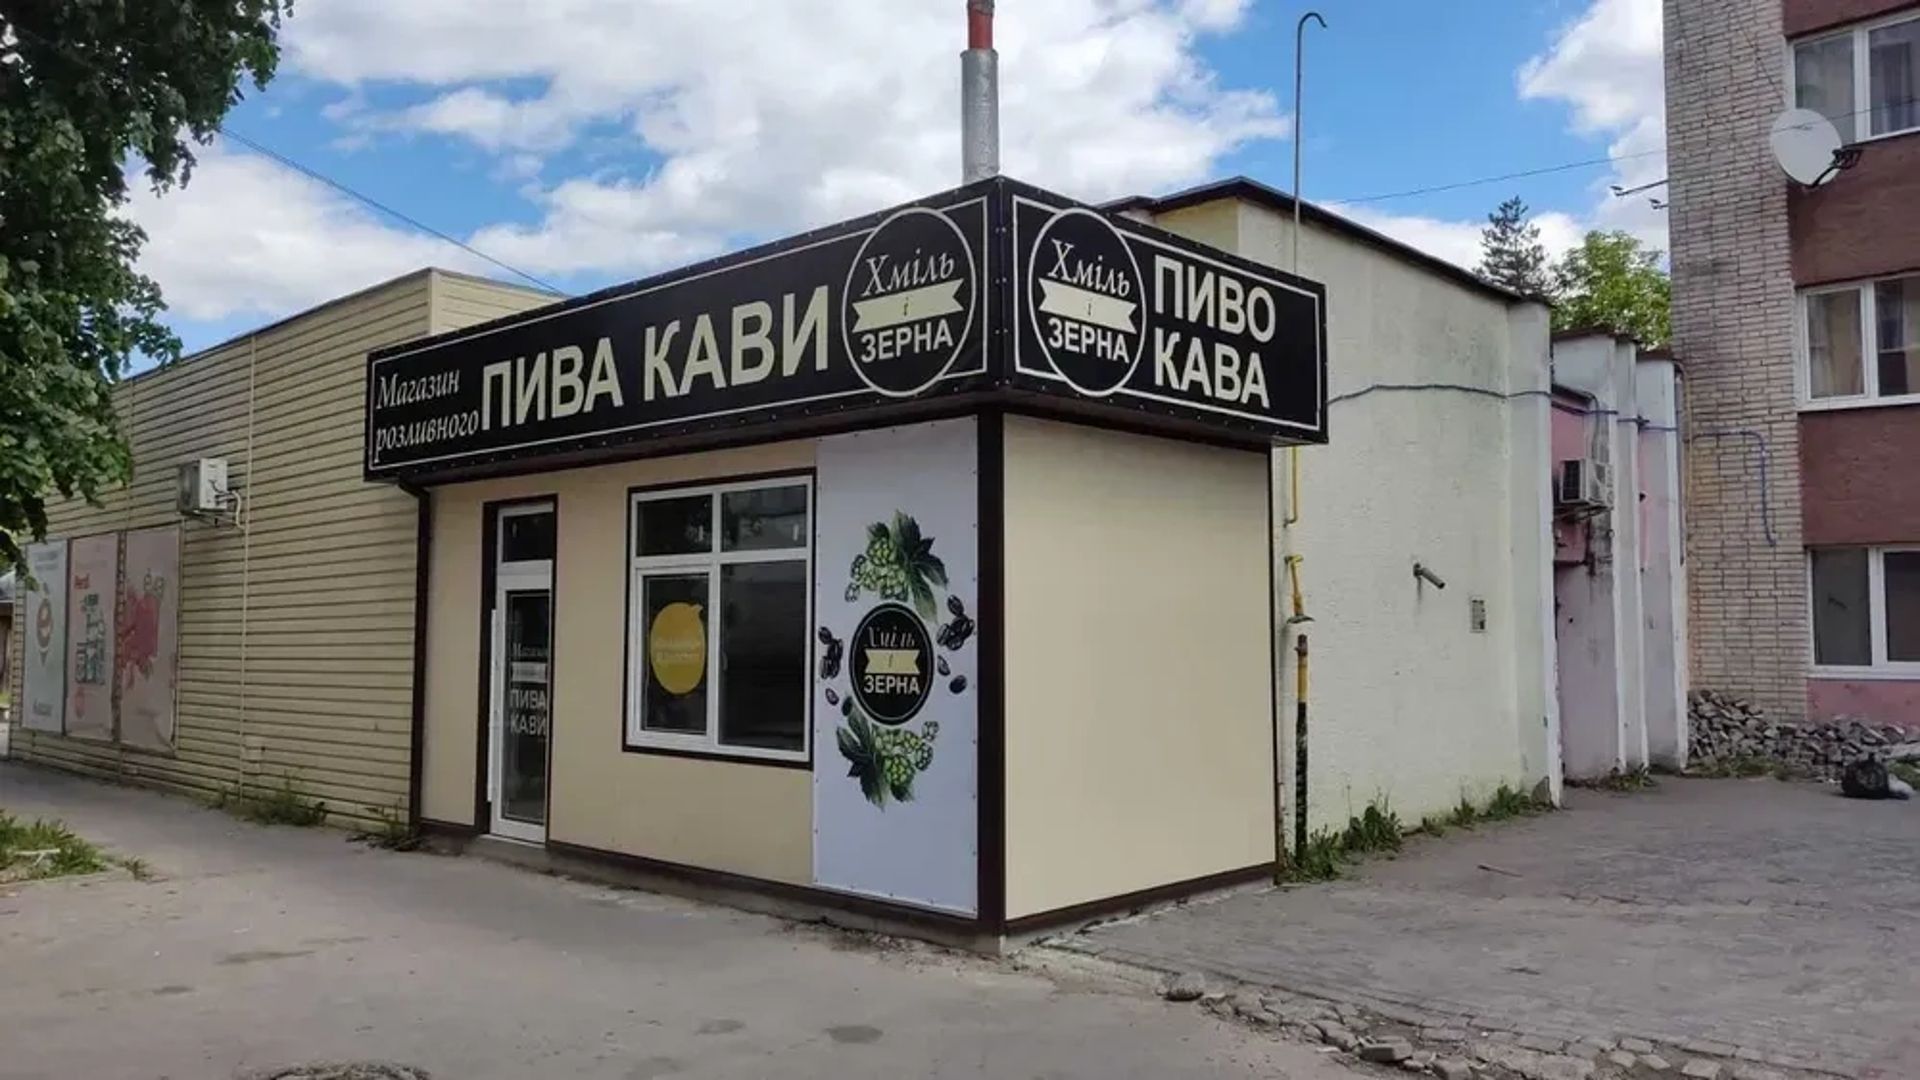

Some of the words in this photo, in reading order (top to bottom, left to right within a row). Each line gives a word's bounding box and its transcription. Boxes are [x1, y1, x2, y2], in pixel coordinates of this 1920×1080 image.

[861, 246, 955, 298] Хміль
[1048, 239, 1131, 298] Хміль
[1154, 254, 1276, 343] ПИВО
[482, 337, 625, 431] ПИВА
[643, 284, 829, 402] КАВИ
[861, 318, 954, 364] ЗЕРНА
[1048, 317, 1130, 364] ЗЕРНА
[376, 369, 461, 410] Магазин
[1154, 327, 1271, 410] КАВА
[374, 409, 479, 463] розливного
[509, 688, 547, 709] ПИВА
[863, 674, 921, 695] ЗЕРНА
[510, 712, 547, 736] КАВИ
